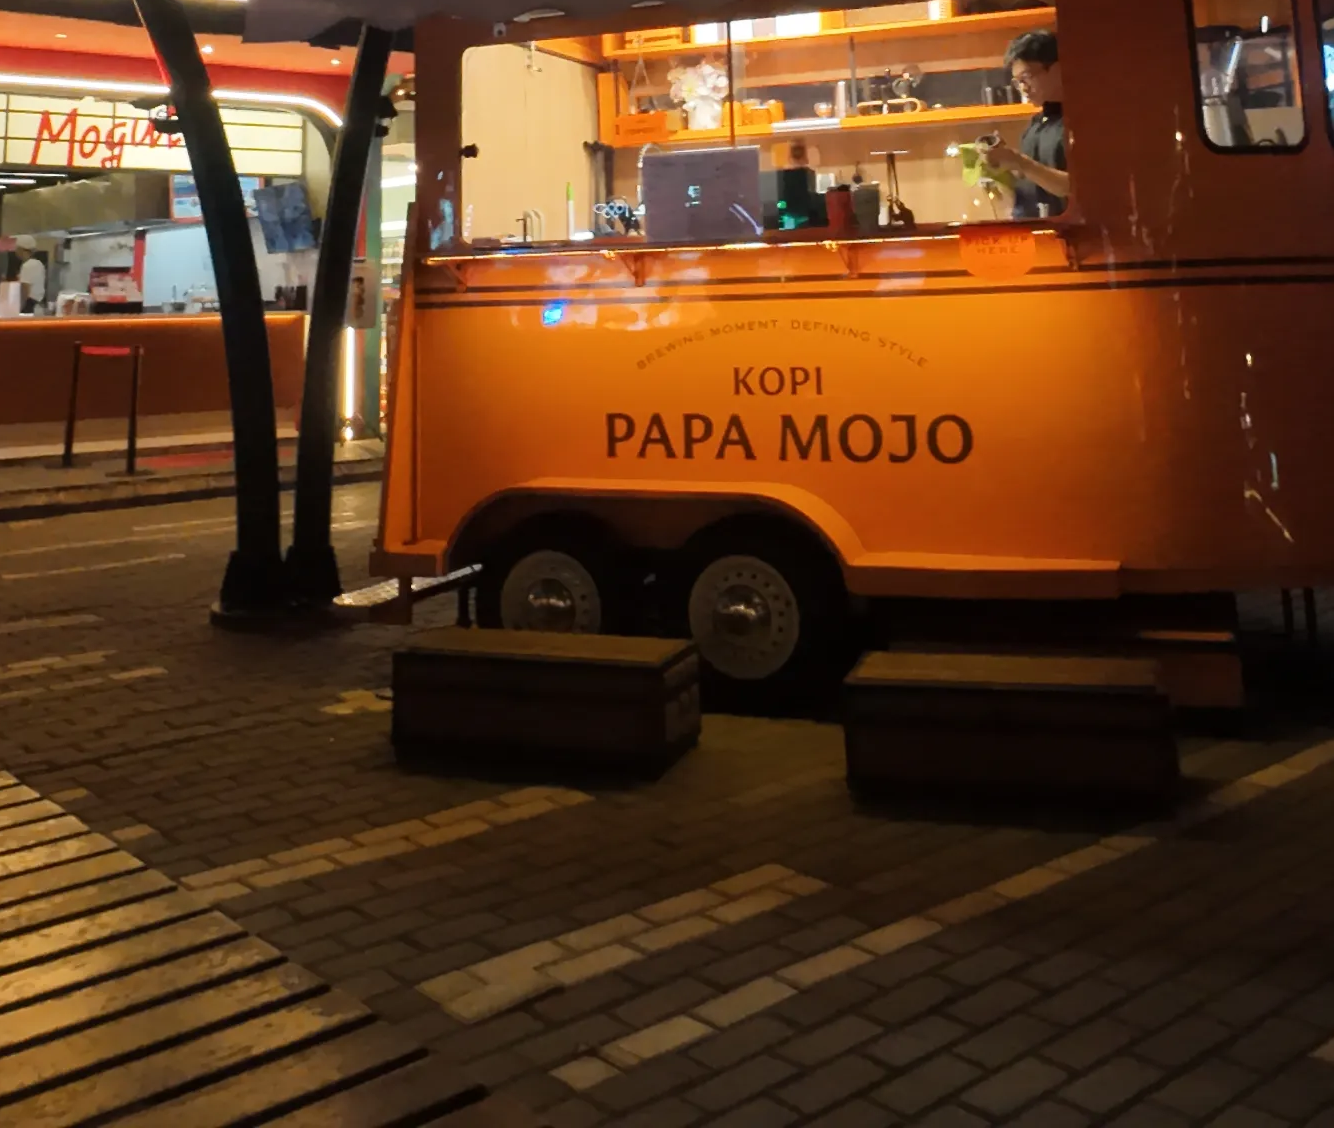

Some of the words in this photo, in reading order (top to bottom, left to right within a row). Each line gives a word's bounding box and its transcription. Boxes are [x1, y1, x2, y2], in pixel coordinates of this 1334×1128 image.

[636, 330, 705, 370] BREWING
[790, 319, 871, 342] DEFINING
[878, 337, 929, 368] STYLE
[733, 366, 823, 396] KOPI
[605, 412, 757, 461] PAPA
[778, 413, 973, 464] MOJO
